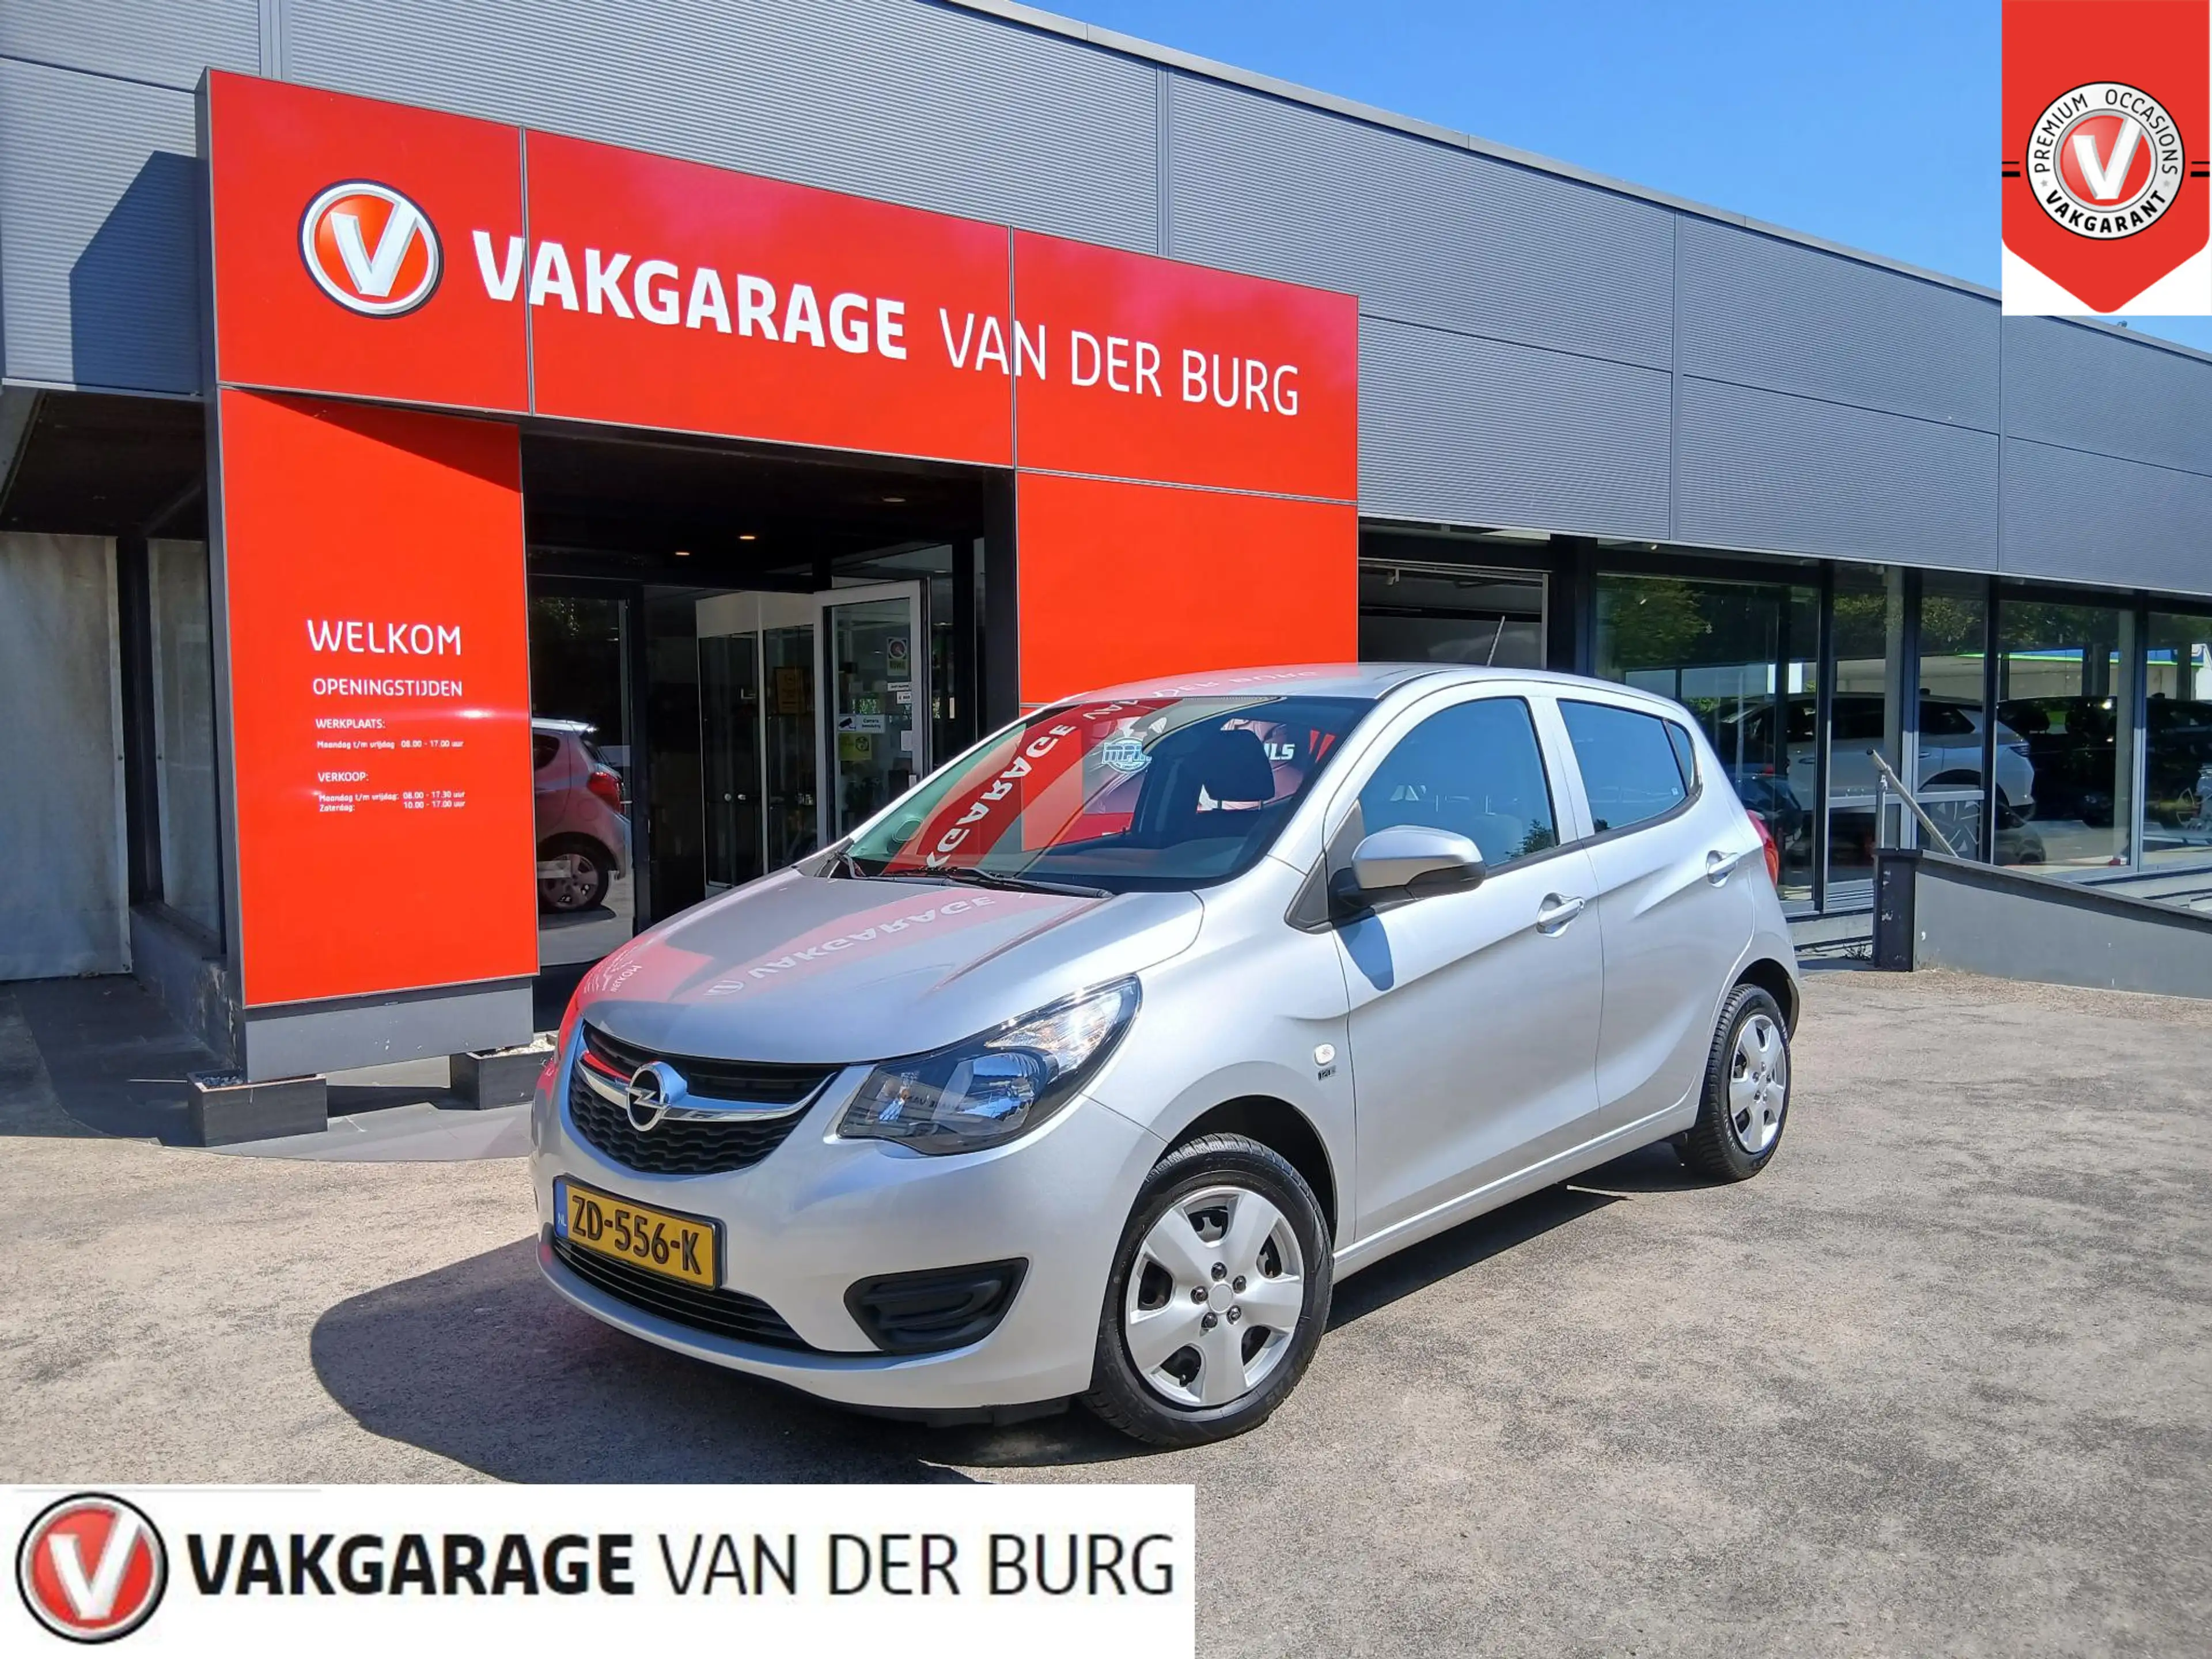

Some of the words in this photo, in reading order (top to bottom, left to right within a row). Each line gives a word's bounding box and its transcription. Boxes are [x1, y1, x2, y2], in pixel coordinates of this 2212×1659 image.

[472, 230, 907, 359] VAKGARAGE
[940, 308, 1046, 380] VAN
[1071, 330, 1162, 397] DER
[1183, 349, 1298, 416] BURG
[307, 619, 461, 656] WELKOM
[313, 678, 463, 696] OPENINGSTIJDEN
[315, 718, 386, 729] WERKPLAATS:
[317, 740, 351, 750] Maandag
[317, 772, 369, 782] VERKOOP:
[557, 1211, 567, 1227] NL
[572, 1194, 702, 1275] ZD-556-K
